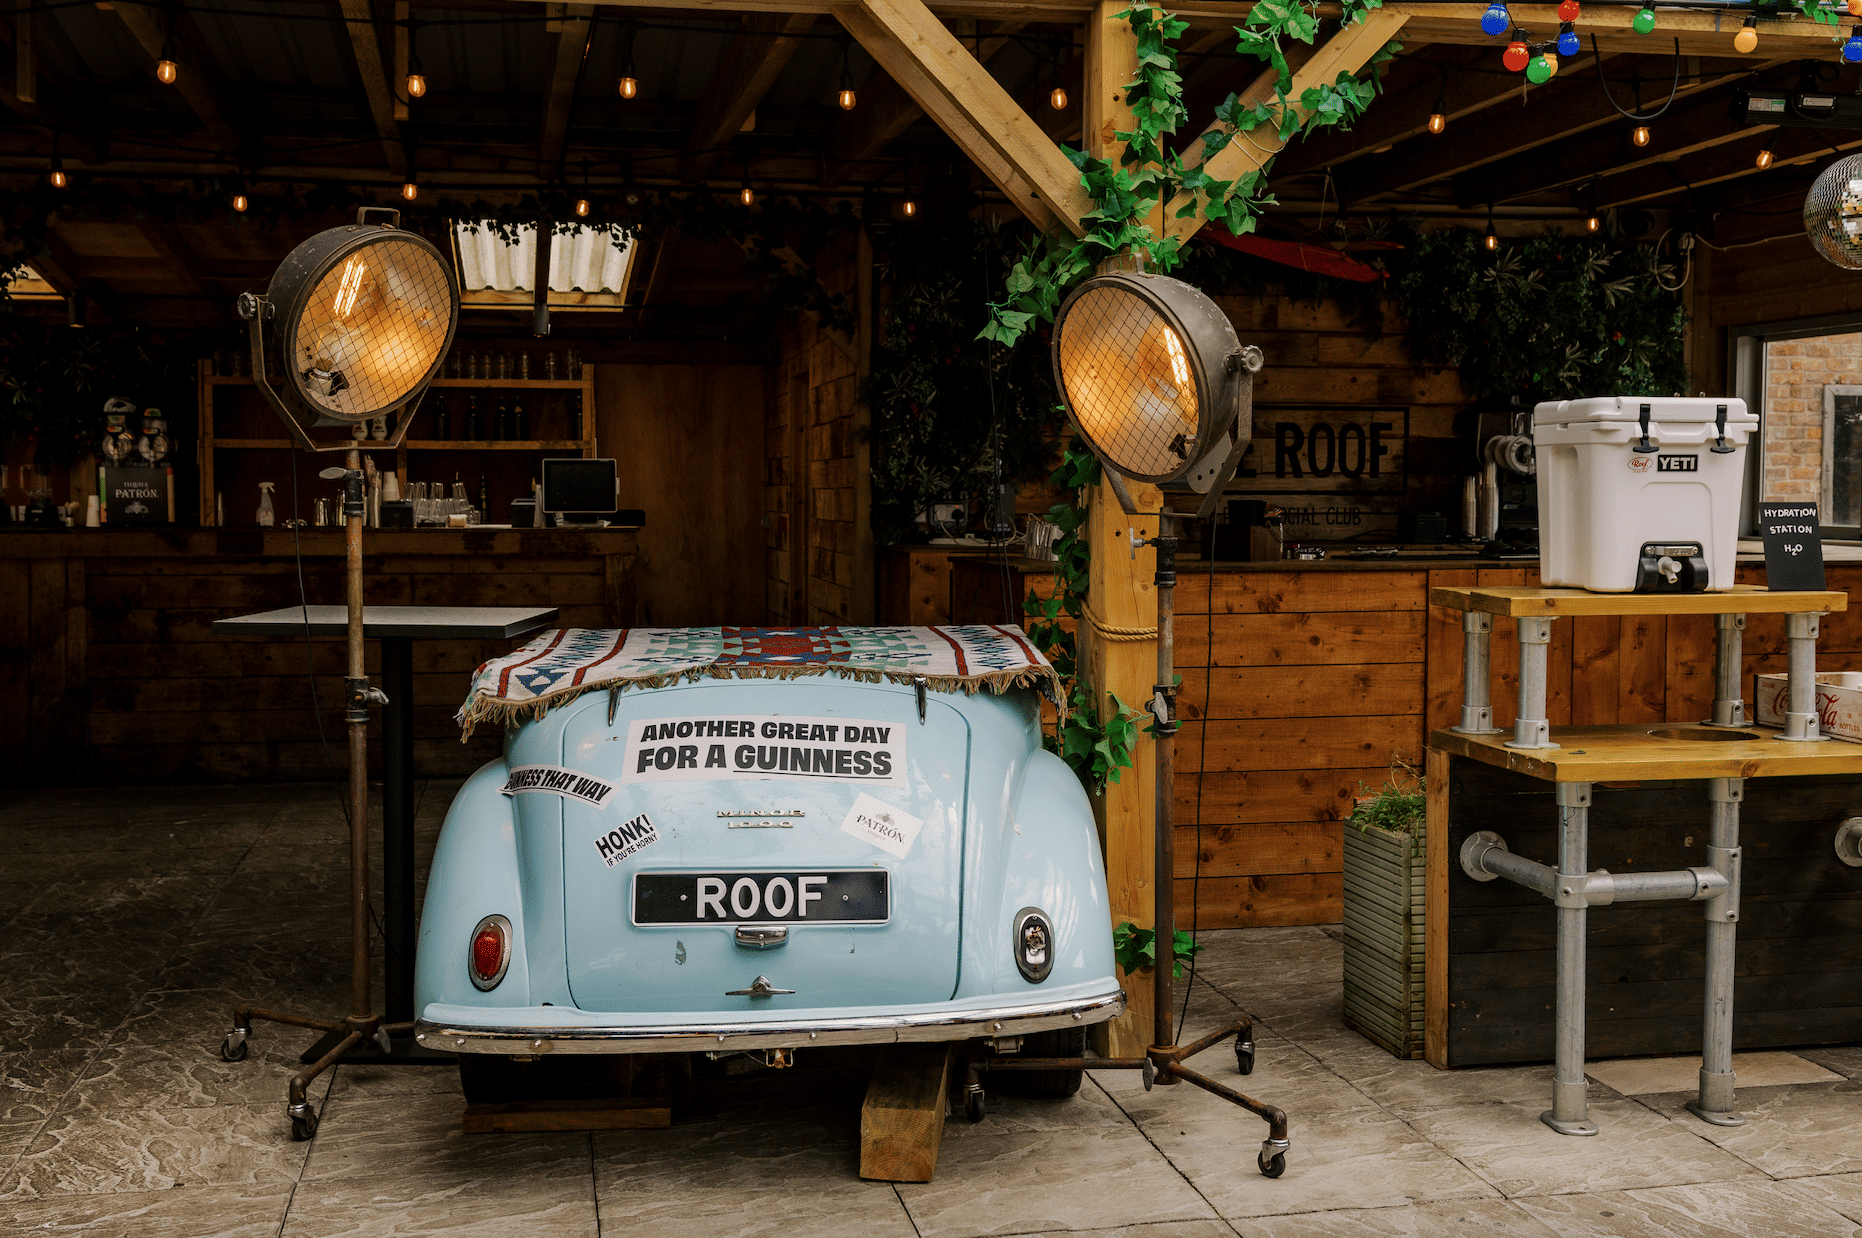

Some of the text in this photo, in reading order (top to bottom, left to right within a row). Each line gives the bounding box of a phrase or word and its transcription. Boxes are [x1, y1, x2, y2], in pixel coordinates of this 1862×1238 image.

[1275, 422, 1393, 479] ROOF
[1658, 456, 1696, 470] YETI
[1279, 506, 1362, 525] OCIAL CLUB
[1763, 508, 1817, 518] HYDRATION
[1769, 524, 1813, 535] STATION
[640, 720, 892, 745] ANOTHER GREAT DAY
[636, 744, 893, 776] FOR A GUINNESS
[540, 769, 578, 791] THAT
[571, 777, 612, 802] WAY
[717, 809, 806, 818] MINOR
[727, 820, 794, 829] 1000
[594, 813, 655, 859] HONK!
[856, 814, 906, 844] PATRÓN
[606, 832, 659, 868] IF YOU'RE HORNY
[695, 875, 829, 919] ROOF
